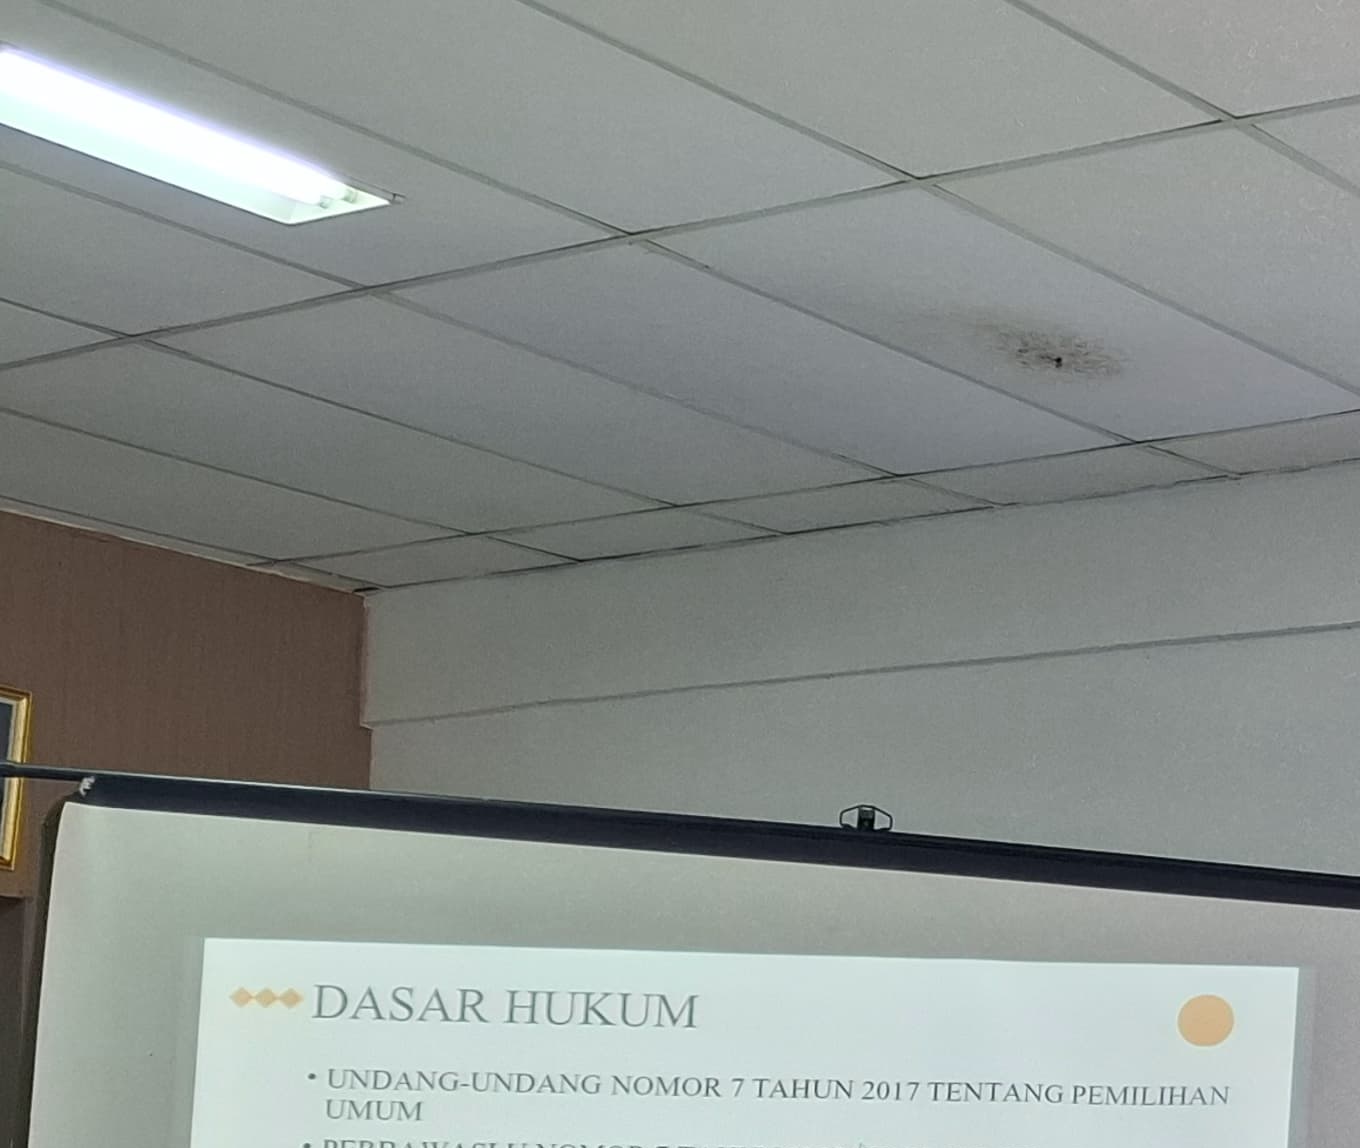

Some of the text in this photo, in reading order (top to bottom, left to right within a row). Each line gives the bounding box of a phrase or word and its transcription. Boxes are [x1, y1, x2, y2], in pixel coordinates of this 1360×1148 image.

[311, 984, 700, 1029] DASAR HUKUM
[327, 1068, 1230, 1106] UNDANG-UNDANG NOMOR 7 TAHUN 2017 TENTANG PEMILIHAN
[325, 1098, 424, 1122] UMUM
